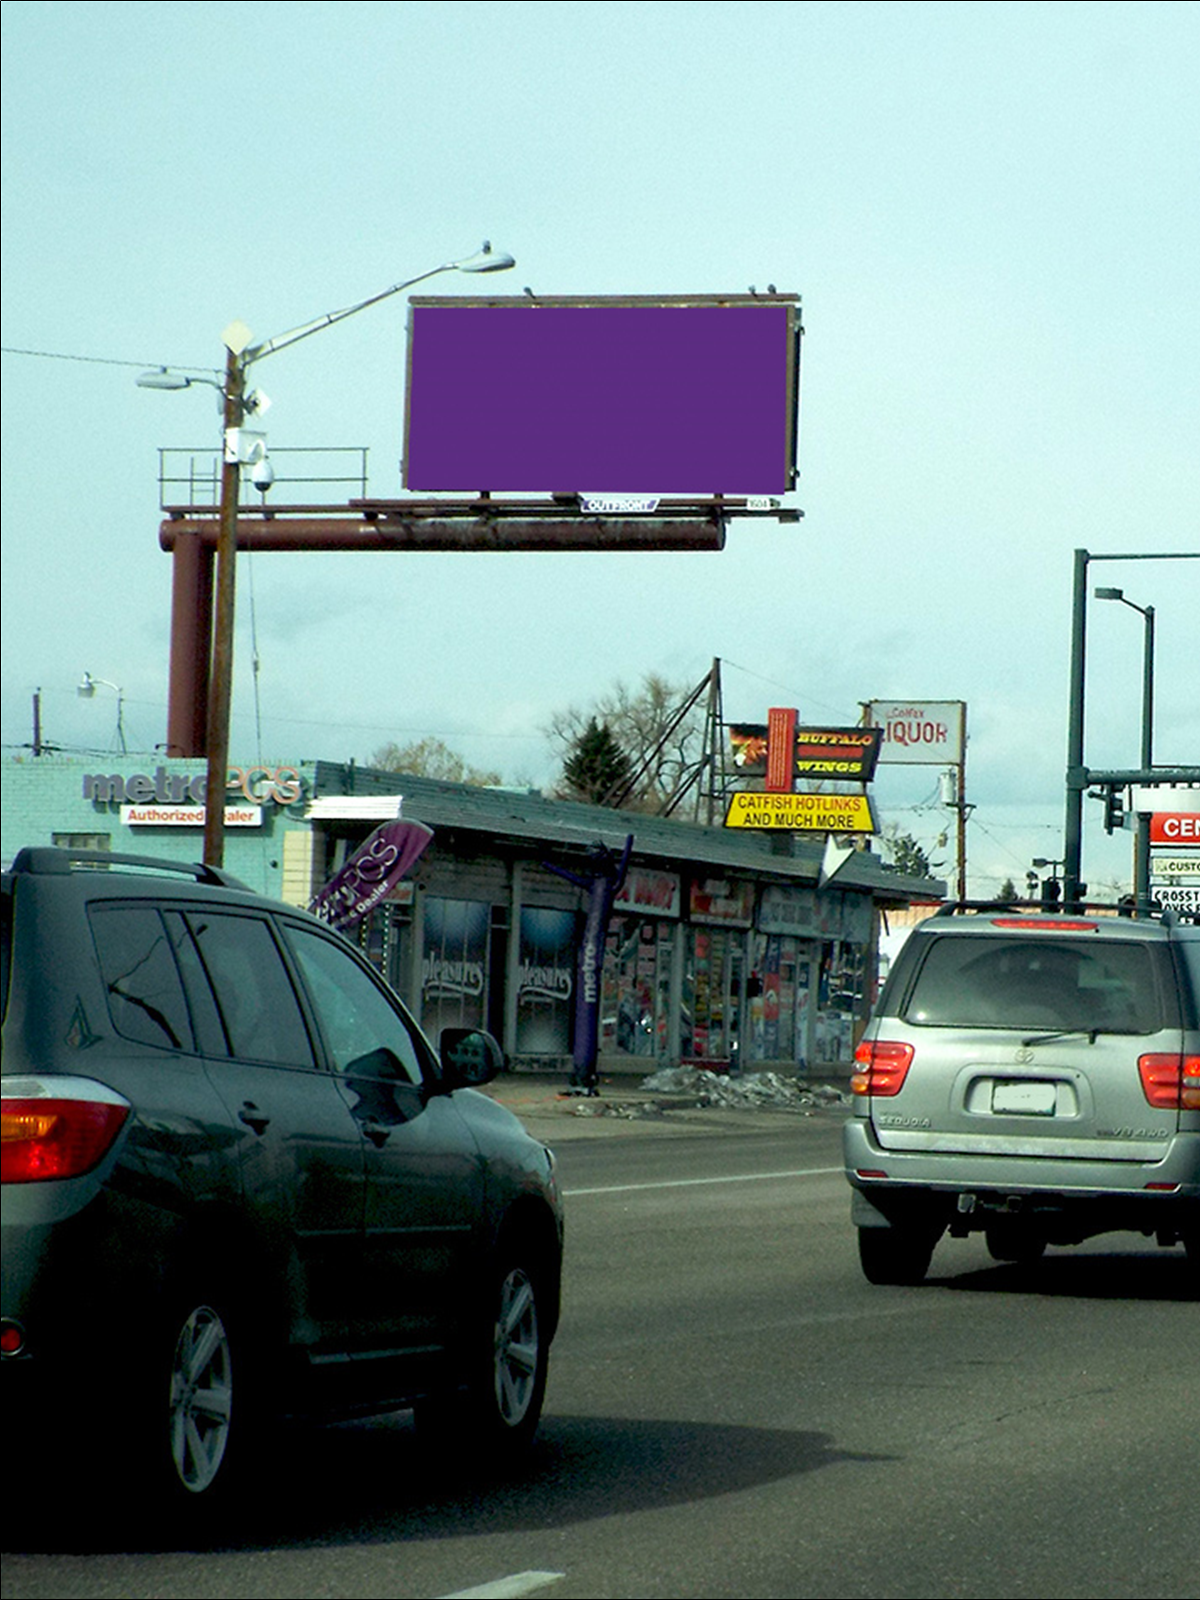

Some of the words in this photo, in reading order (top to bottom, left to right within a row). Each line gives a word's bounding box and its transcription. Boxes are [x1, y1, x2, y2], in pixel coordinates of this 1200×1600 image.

[588, 499, 649, 511] OUTFRONT
[797, 732, 873, 746] BUFFALO
[797, 761, 862, 772] WINGS
[738, 795, 792, 809] CATFISH
[796, 797, 861, 811] HOTLINKS
[128, 809, 205, 822] Authorized
[743, 813, 771, 825] AND
[774, 813, 813, 827] MUCH
[817, 814, 854, 828] MORE
[356, 880, 389, 913] Dealer
[583, 942, 597, 1003] metro
[879, 1115, 932, 1128] SEQUOIA
